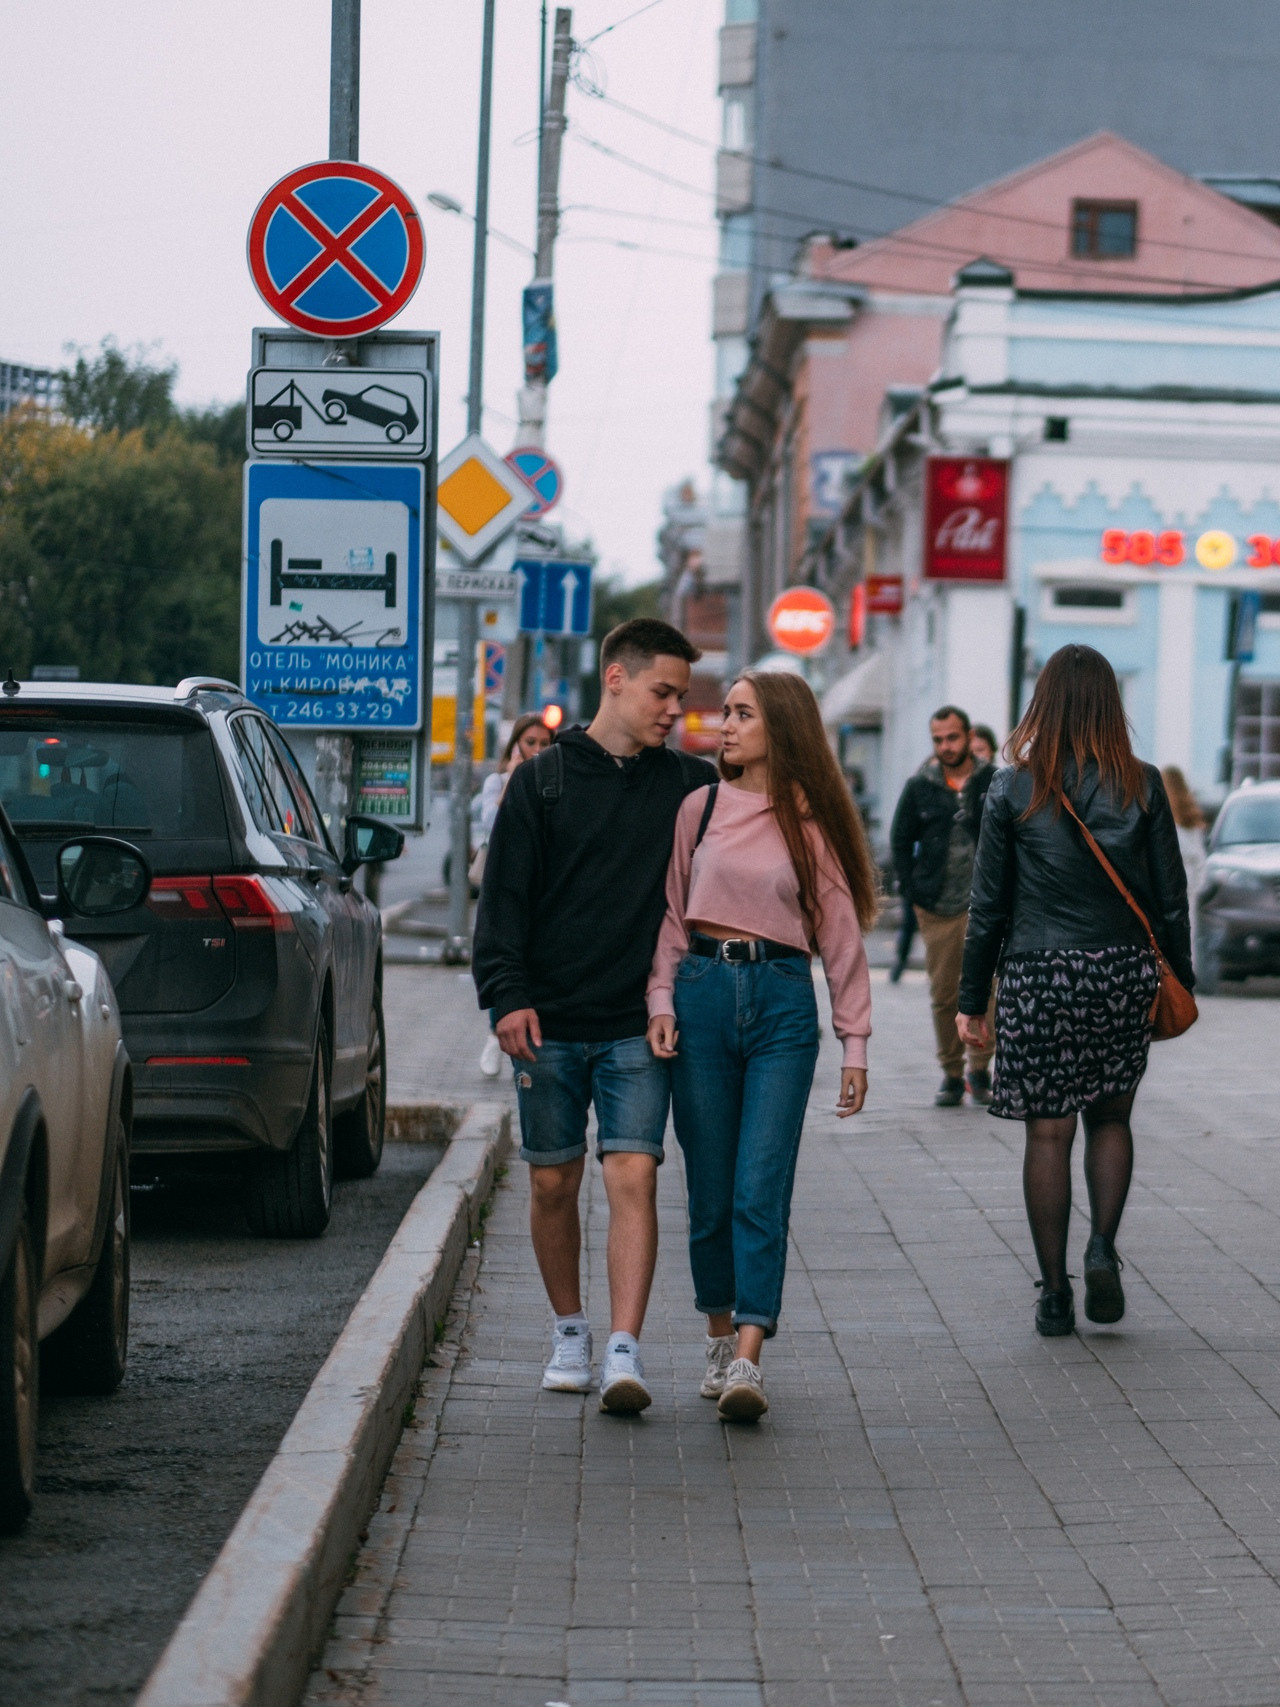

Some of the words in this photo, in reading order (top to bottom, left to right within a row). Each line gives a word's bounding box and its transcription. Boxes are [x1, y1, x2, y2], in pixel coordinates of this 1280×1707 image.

[1102, 529, 1186, 566] 585
[250, 652, 312, 668] ОТЕЛЬ
[320, 653, 414, 671] "МОНИКА"
[203, 938, 226, 947] TSI
